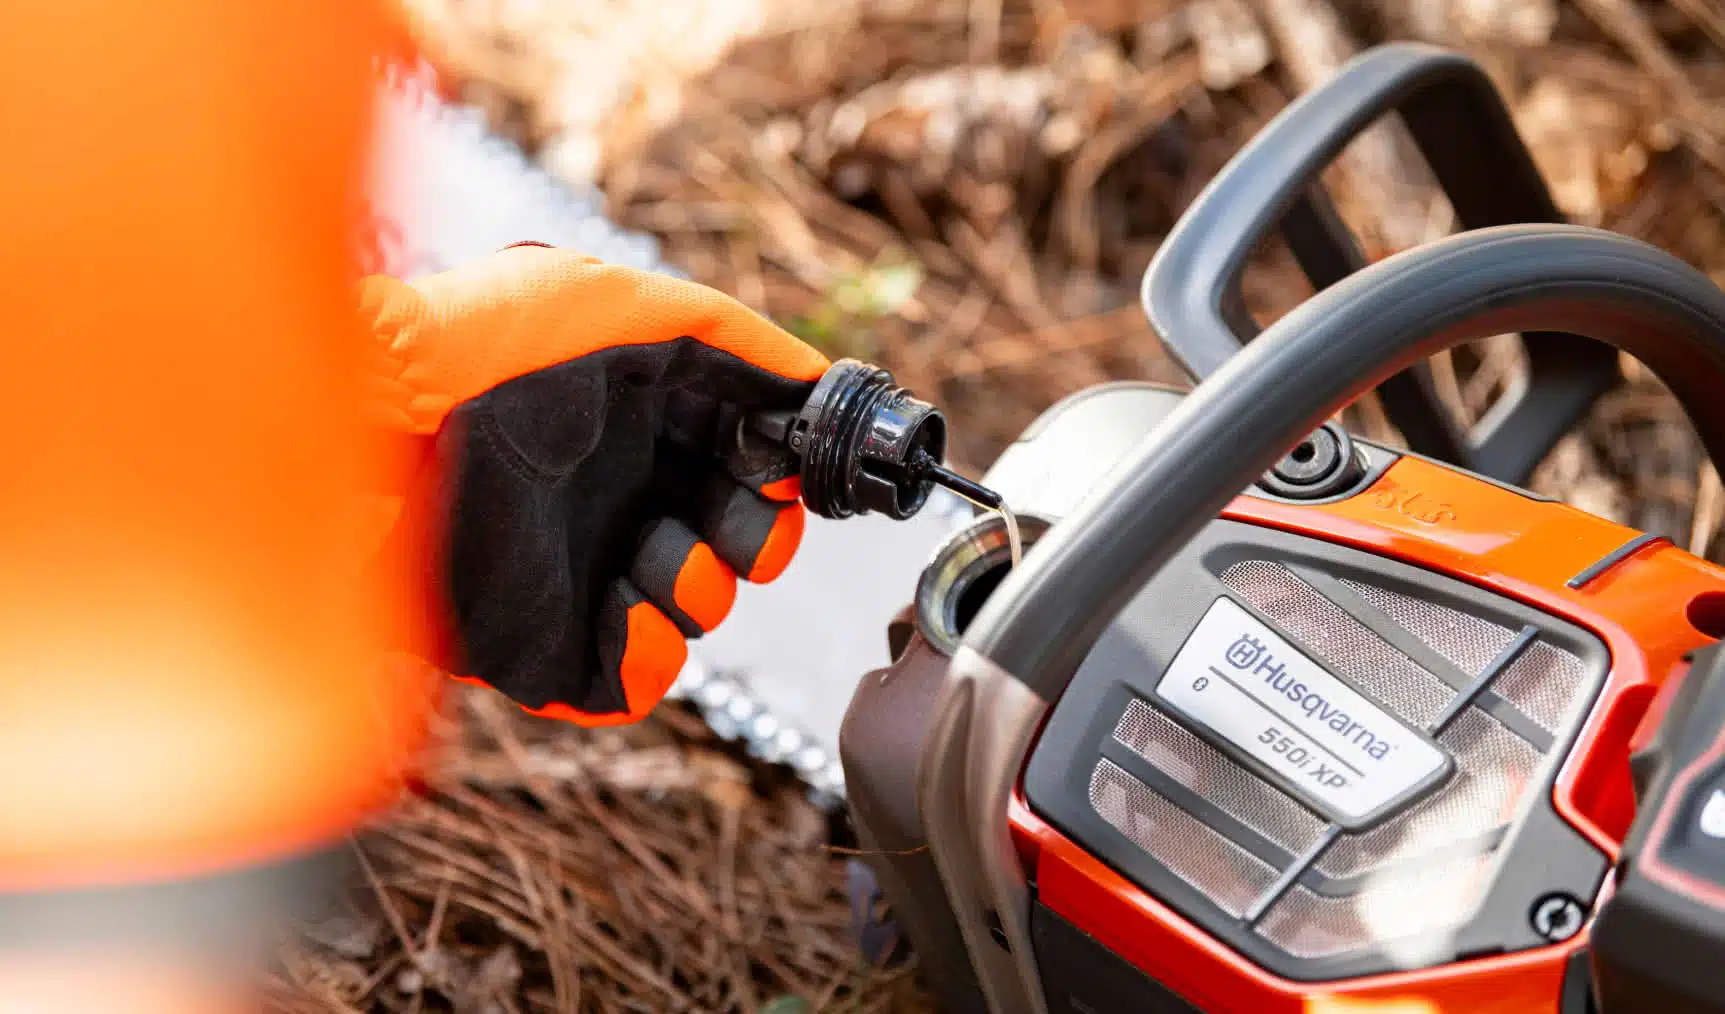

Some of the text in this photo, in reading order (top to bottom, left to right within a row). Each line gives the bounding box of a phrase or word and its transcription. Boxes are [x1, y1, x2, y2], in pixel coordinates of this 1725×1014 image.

[1252, 654, 1390, 760] Husqvarna
[1257, 727, 1348, 788] 550i XP
